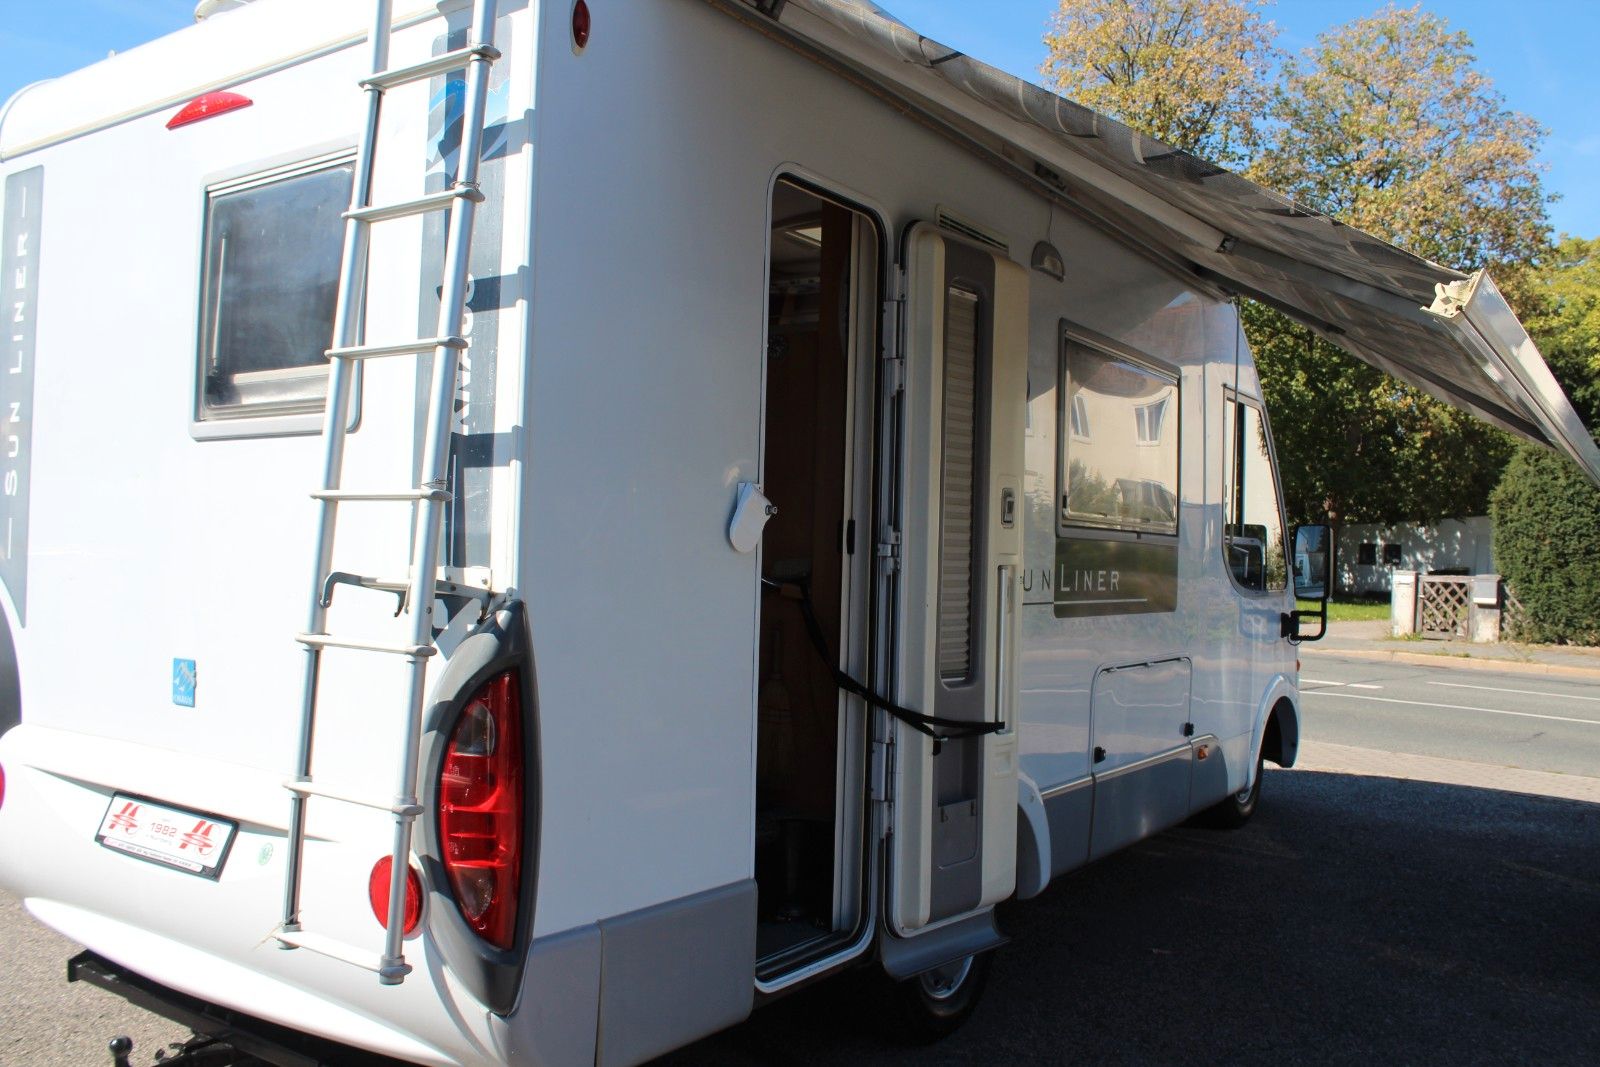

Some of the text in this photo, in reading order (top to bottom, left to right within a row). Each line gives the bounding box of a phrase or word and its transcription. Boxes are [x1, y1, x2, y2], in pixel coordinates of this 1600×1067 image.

[5, 232, 28, 496] SUN LINER
[1060, 563, 1120, 592] LINER
